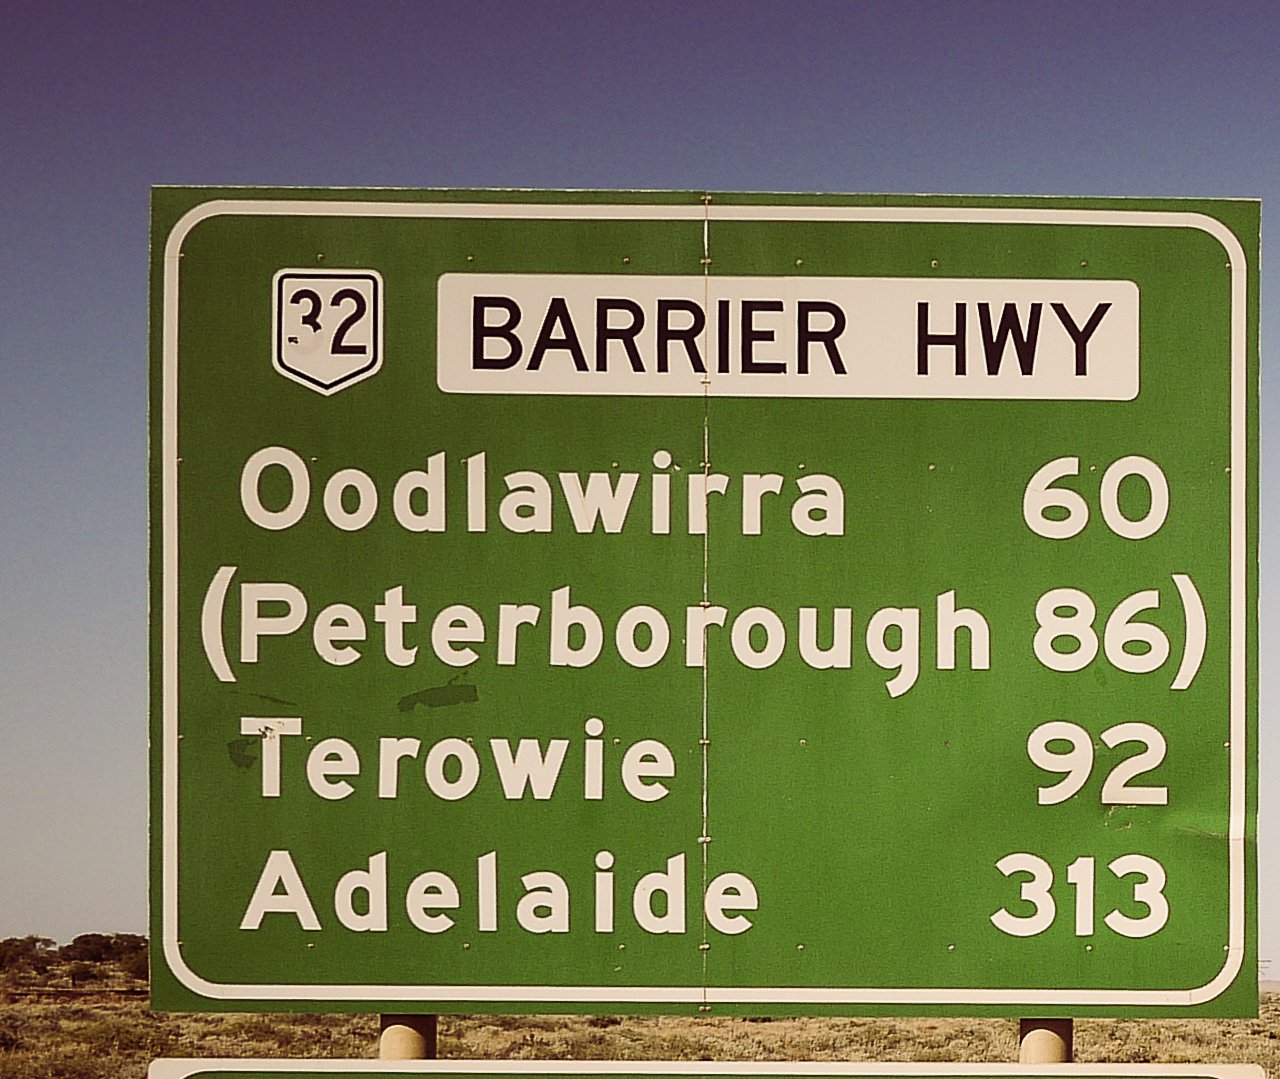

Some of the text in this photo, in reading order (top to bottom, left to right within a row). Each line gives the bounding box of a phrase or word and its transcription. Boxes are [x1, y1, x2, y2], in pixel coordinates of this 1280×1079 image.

[472, 296, 1113, 376] BARRIER HWY
[240, 446, 1169, 540] Oodlawirra 60
[201, 567, 1207, 698] (Peterborough 86)
[240, 717, 1168, 805] Terowie 92
[239, 850, 1169, 938] Adelaide 313
